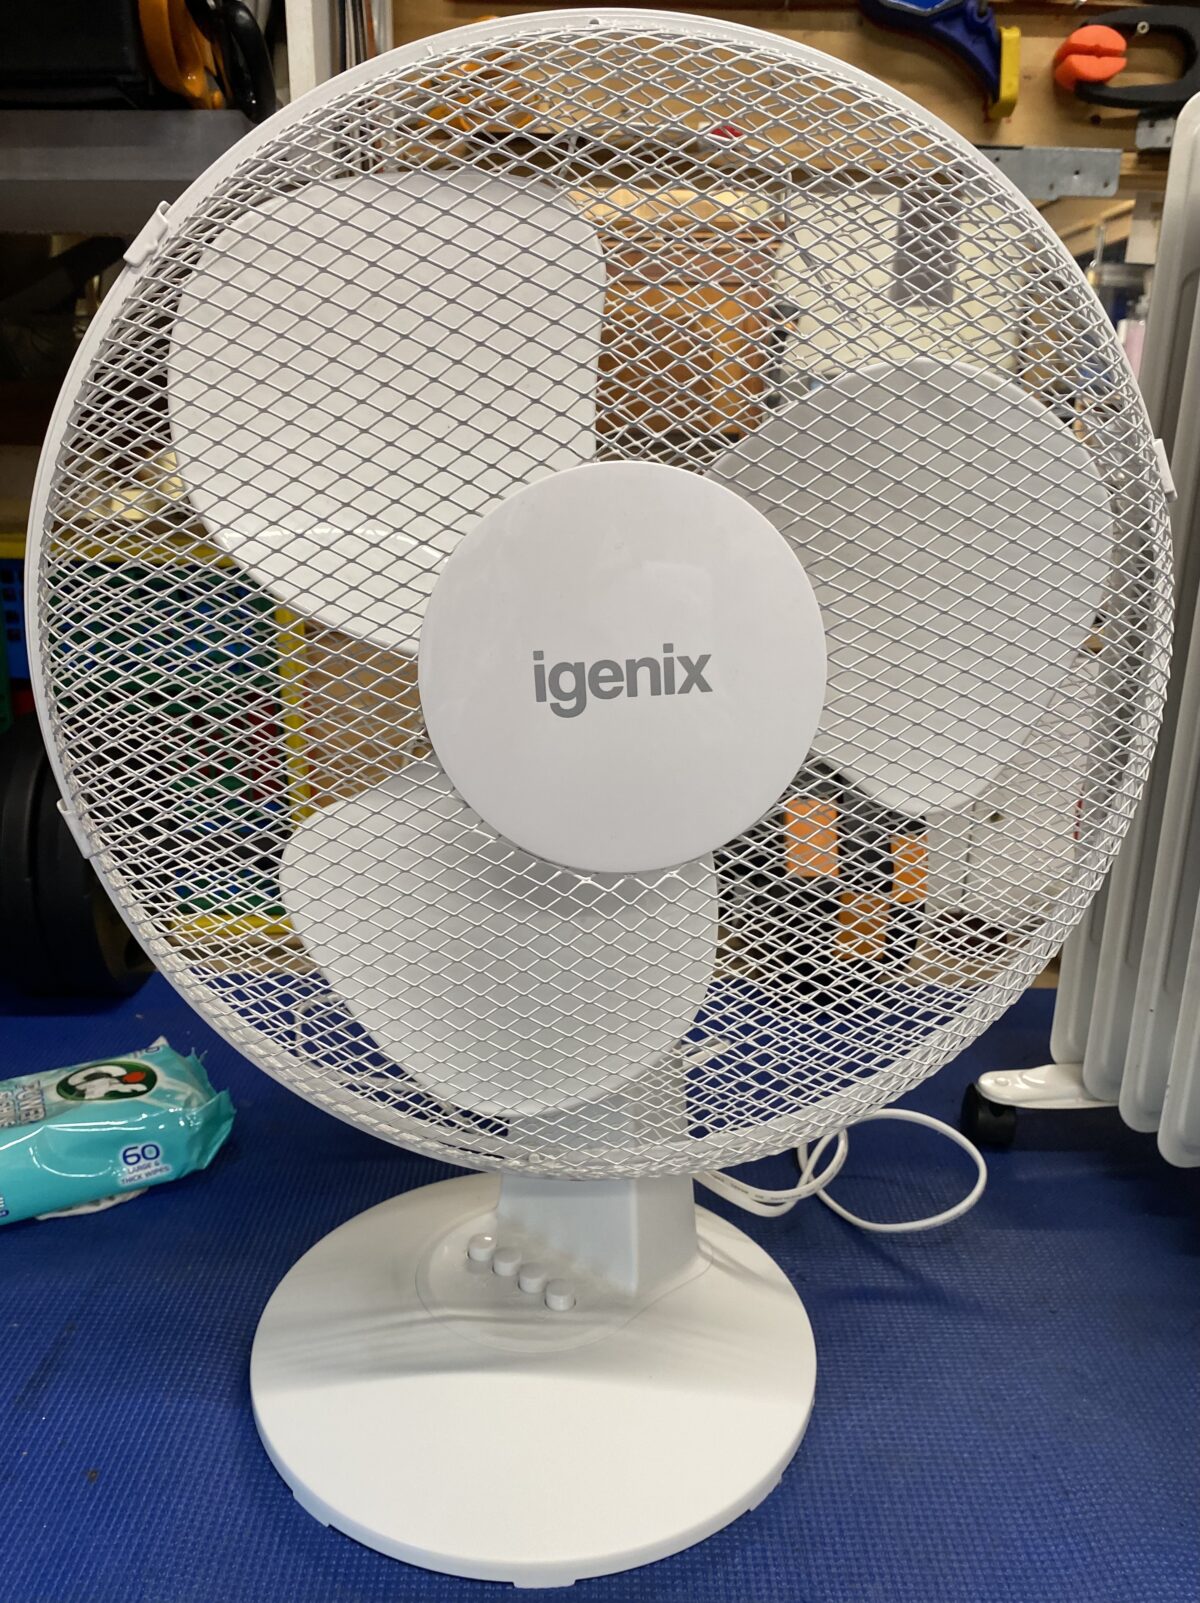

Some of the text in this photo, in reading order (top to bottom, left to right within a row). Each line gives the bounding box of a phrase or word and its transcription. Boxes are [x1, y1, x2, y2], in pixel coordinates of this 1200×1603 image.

[533, 643, 713, 718] igenix
[122, 1144, 160, 1166] 60
[121, 1165, 170, 1184] THICK WIPES
